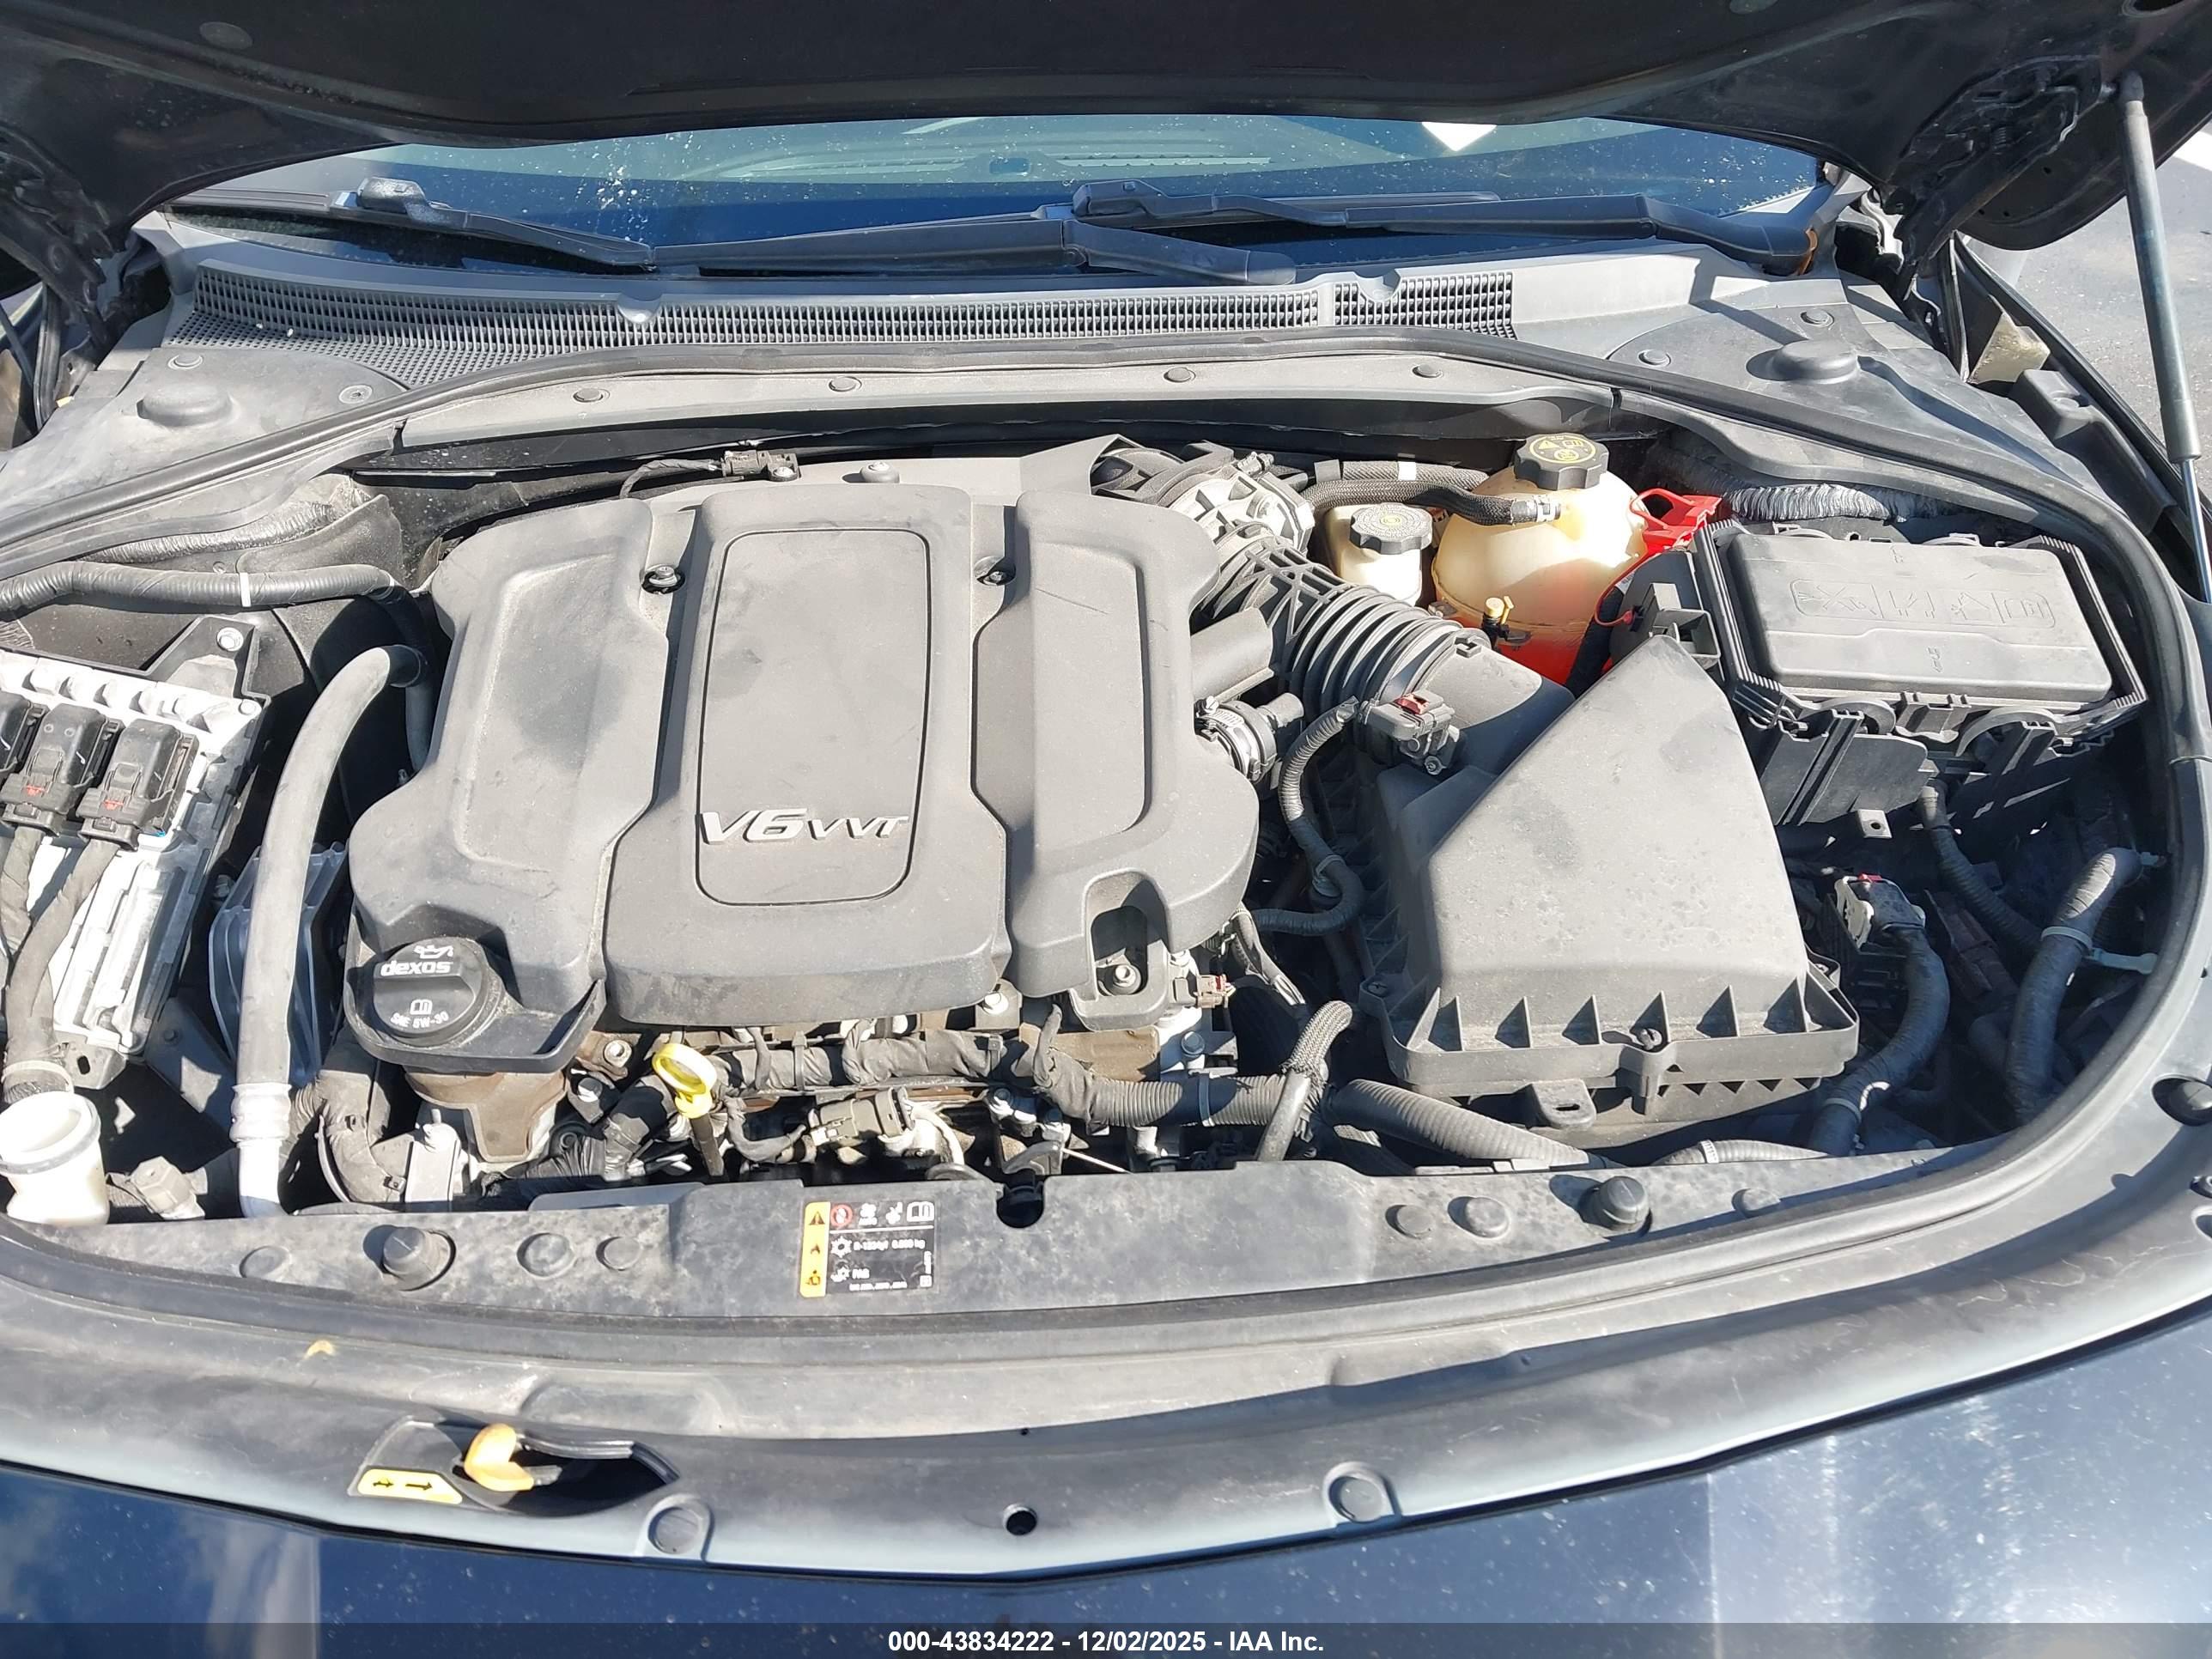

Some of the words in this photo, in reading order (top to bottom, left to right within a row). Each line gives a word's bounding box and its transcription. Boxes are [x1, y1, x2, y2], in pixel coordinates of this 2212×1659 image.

[702, 808, 808, 845] V6
[809, 816, 910, 841] VVT
[380, 960, 454, 976] dexos
[412, 1011, 449, 1030] 5W-30
